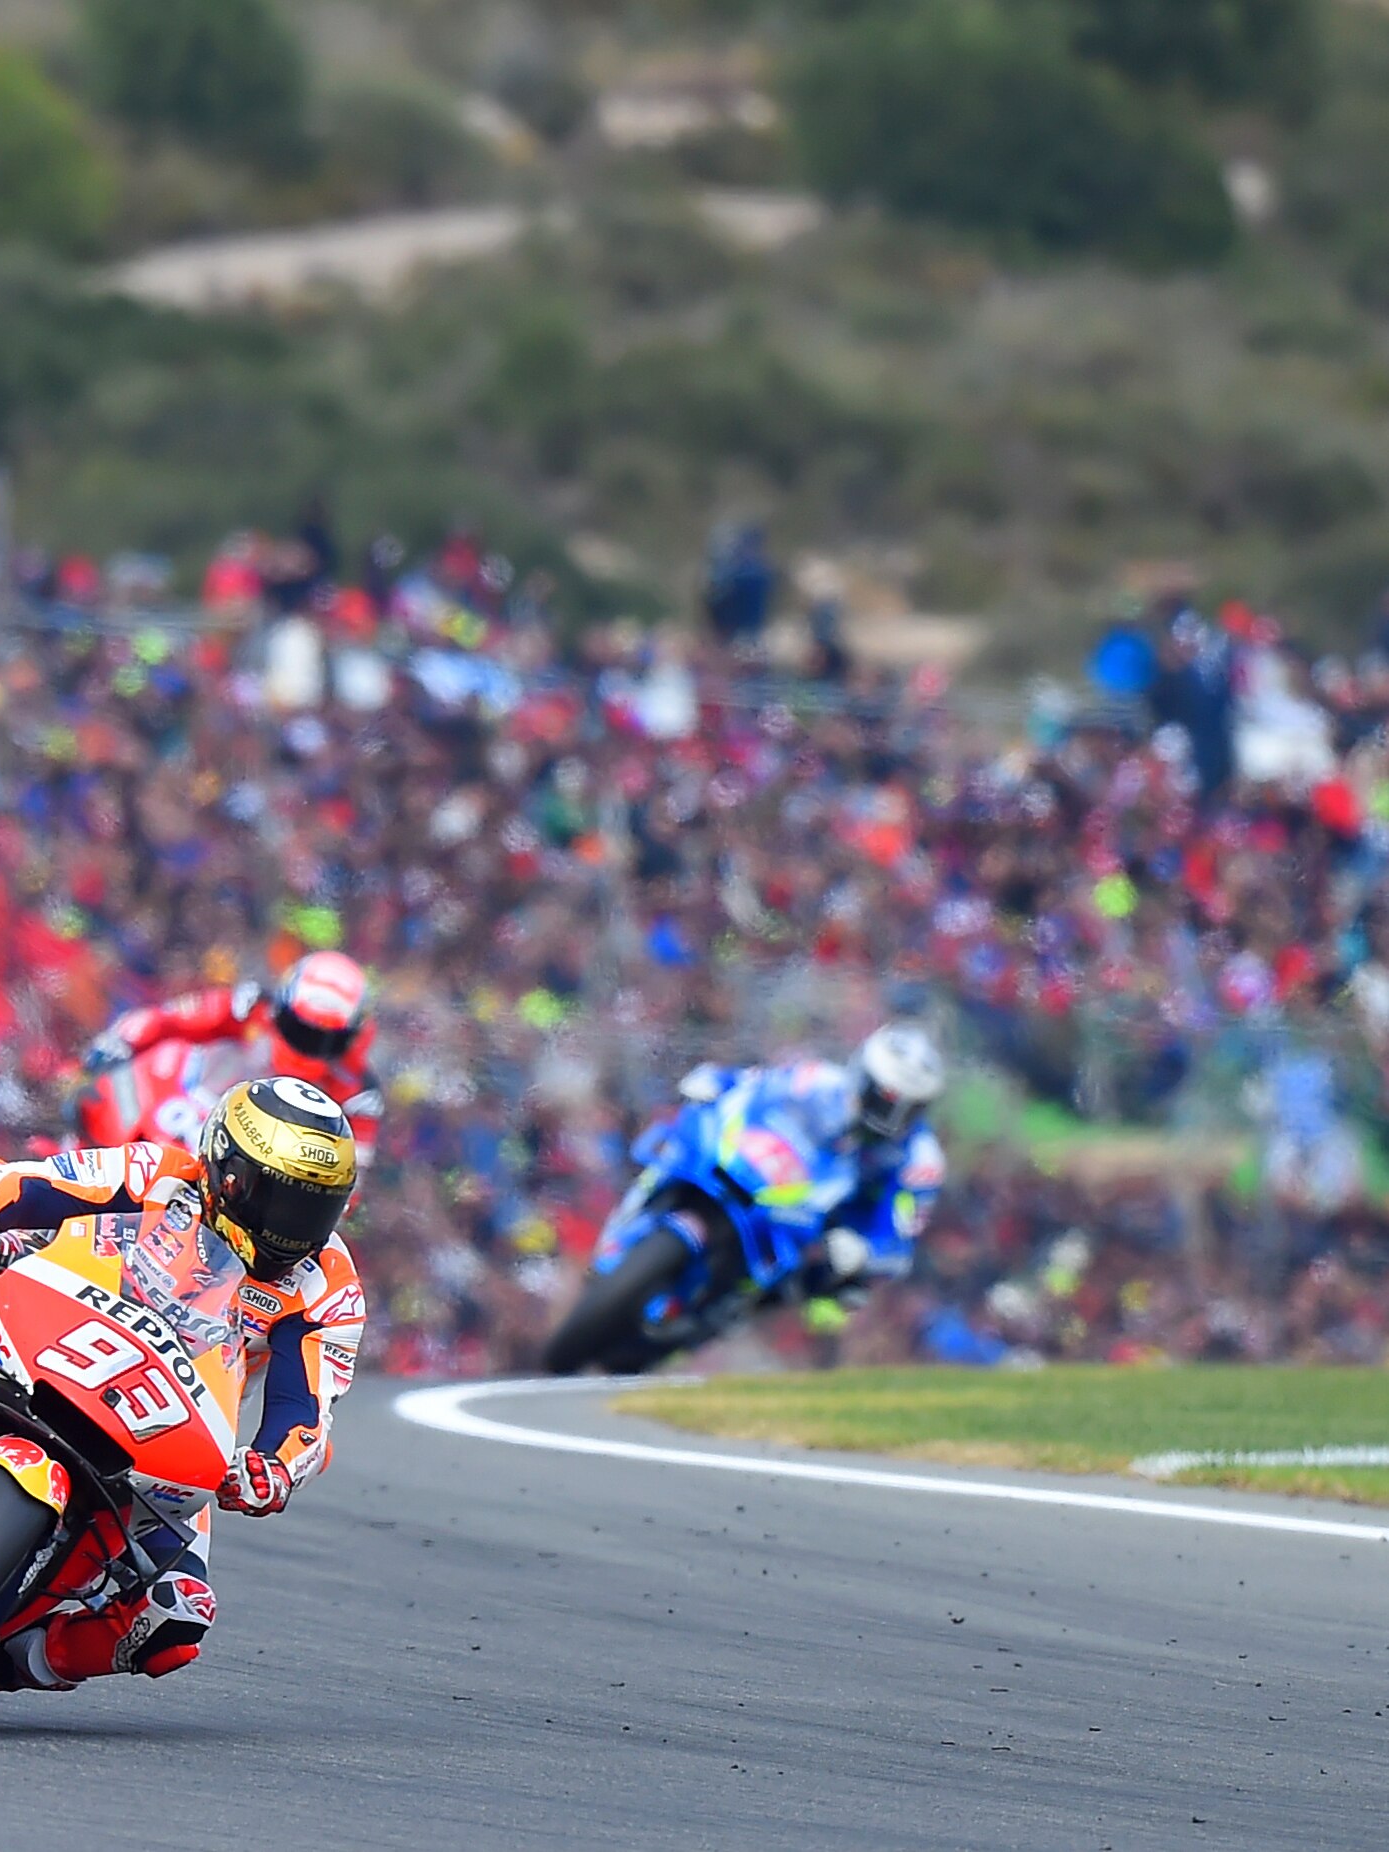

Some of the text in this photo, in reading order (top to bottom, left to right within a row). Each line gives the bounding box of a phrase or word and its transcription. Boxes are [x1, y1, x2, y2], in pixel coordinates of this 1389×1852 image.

[233, 1102, 274, 1160] PULL&BEAR
[300, 1144, 336, 1167] SHOEI
[299, 1179, 324, 1195] YOU
[135, 1245, 162, 1277] Allianz
[243, 1285, 278, 1313] SHOEI
[75, 1285, 207, 1408] REPSOL
[33, 1318, 192, 1445] 93
